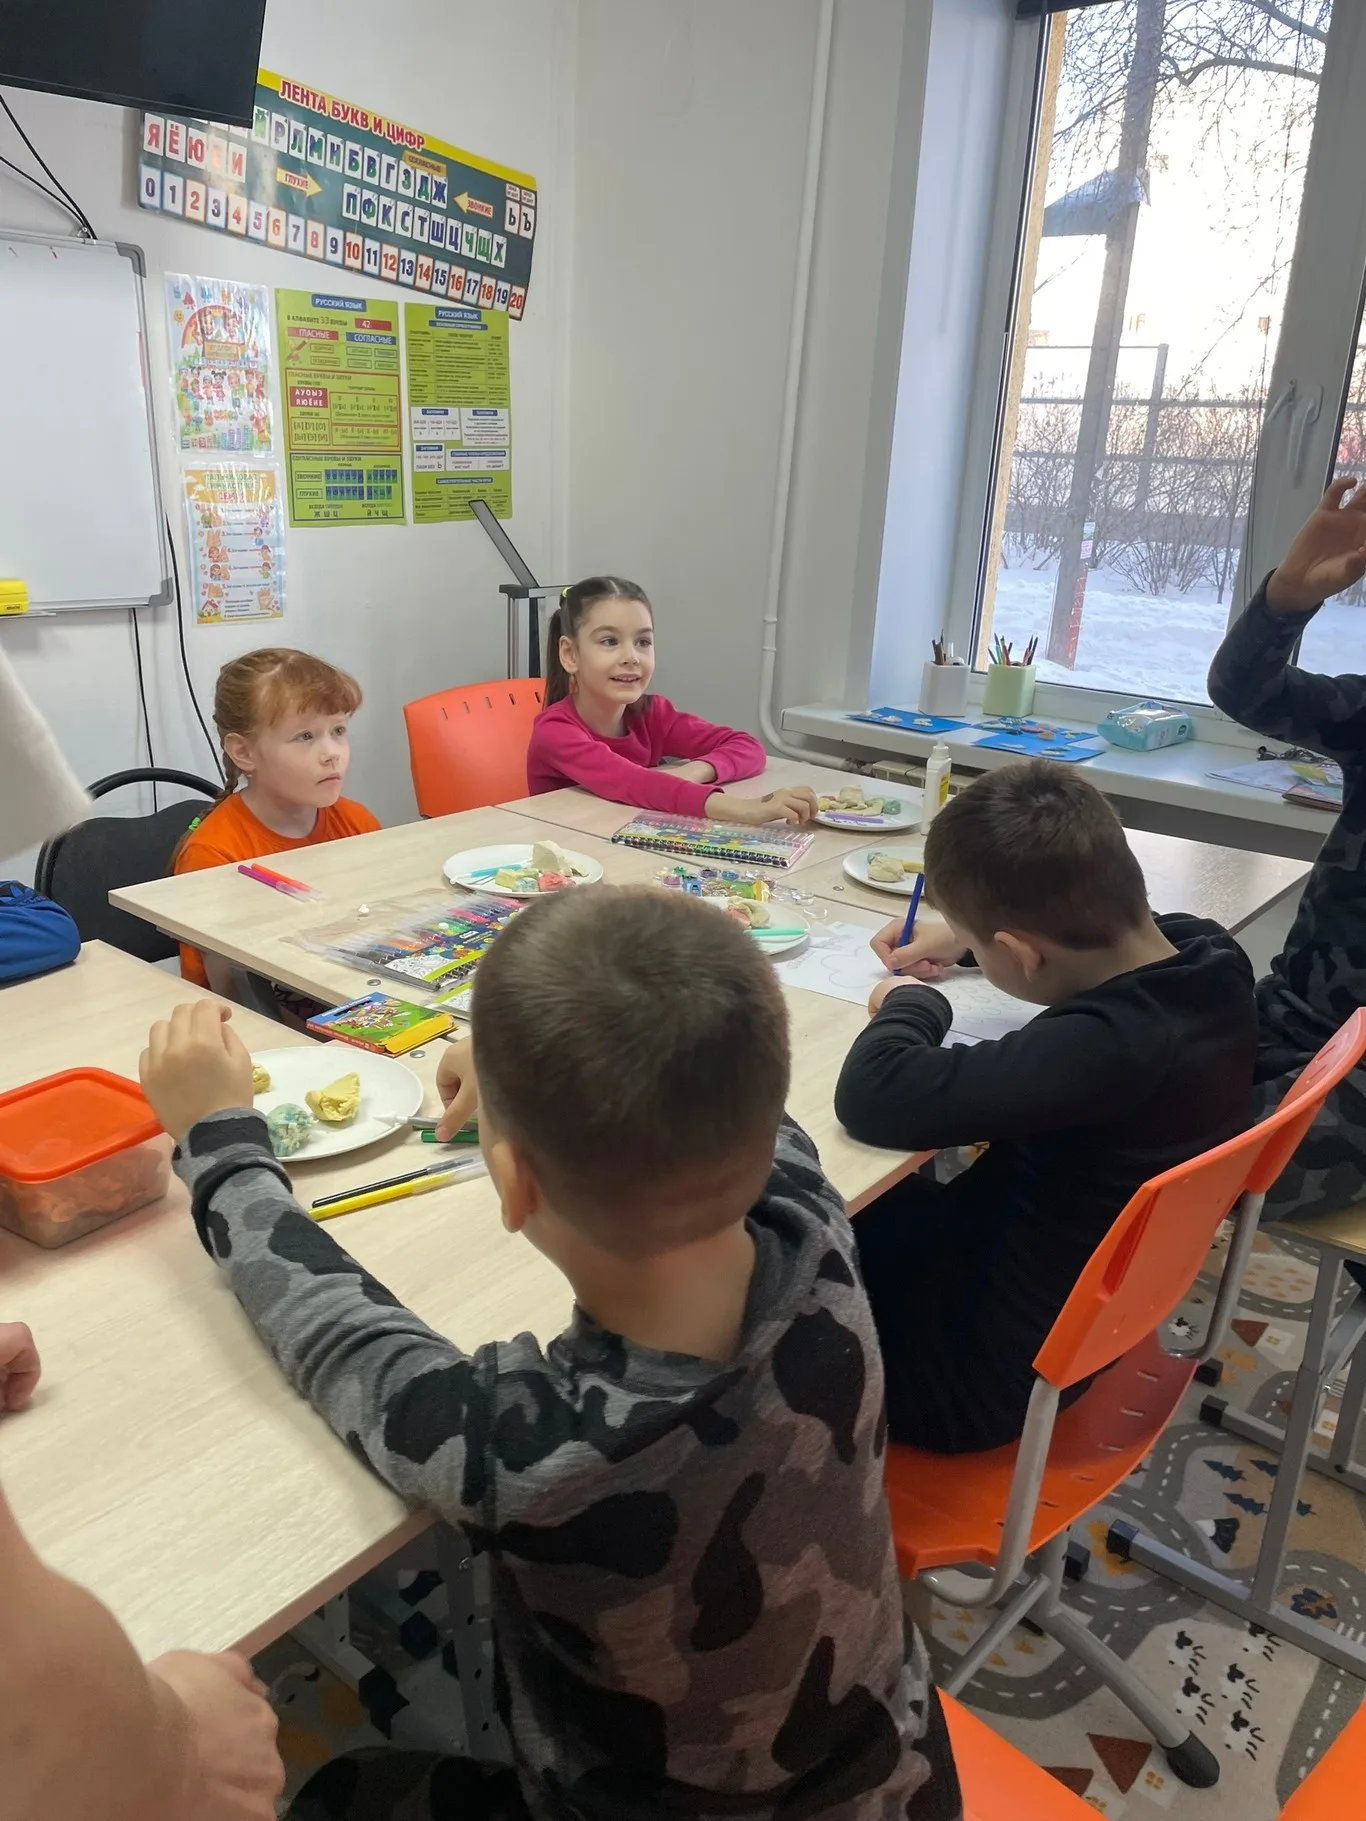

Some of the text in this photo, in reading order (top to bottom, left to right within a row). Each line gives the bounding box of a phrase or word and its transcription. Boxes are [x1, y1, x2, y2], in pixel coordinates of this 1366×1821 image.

[281, 80, 425, 150] ЛЕНТА БУКВ И ЦИФР
[148, 123, 160, 148] Я
[168, 124, 179, 155] Ё
[188, 135, 205, 164] Ю
[232, 151, 243, 176] И
[274, 120, 286, 144] Р
[291, 128, 302, 153] Л
[309, 135, 323, 160] М
[329, 142, 341, 167] Н
[348, 149, 360, 172] Б
[366, 156, 377, 178] В
[385, 162, 396, 184] Г
[401, 168, 412, 190] З
[417, 175, 430, 201] Д
[432, 180, 447, 204] Ж
[284, 173, 309, 190] ГЛУХИЕ
[467, 199, 492, 216] ЗВОНКИЕ
[346, 192, 504, 263] П Ф К С Т Ш Ц Ч Щ Х
[523, 212, 532, 232] Ъ
[145, 177, 523, 309] 0 1 2 3 4 5 6 7 8 9 10 11 12 13 14 15 16 17 18 19 20
[315, 298, 363, 309] РУССКИЙ ЯЗЫК
[320, 316, 330, 325] 33
[438, 310, 463, 319] РУССКИЙ
[362, 320, 371, 328] 42
[299, 328, 330, 339] ГЛАСНЫЕ
[353, 333, 392, 344] СОГЛАСНЫЕ
